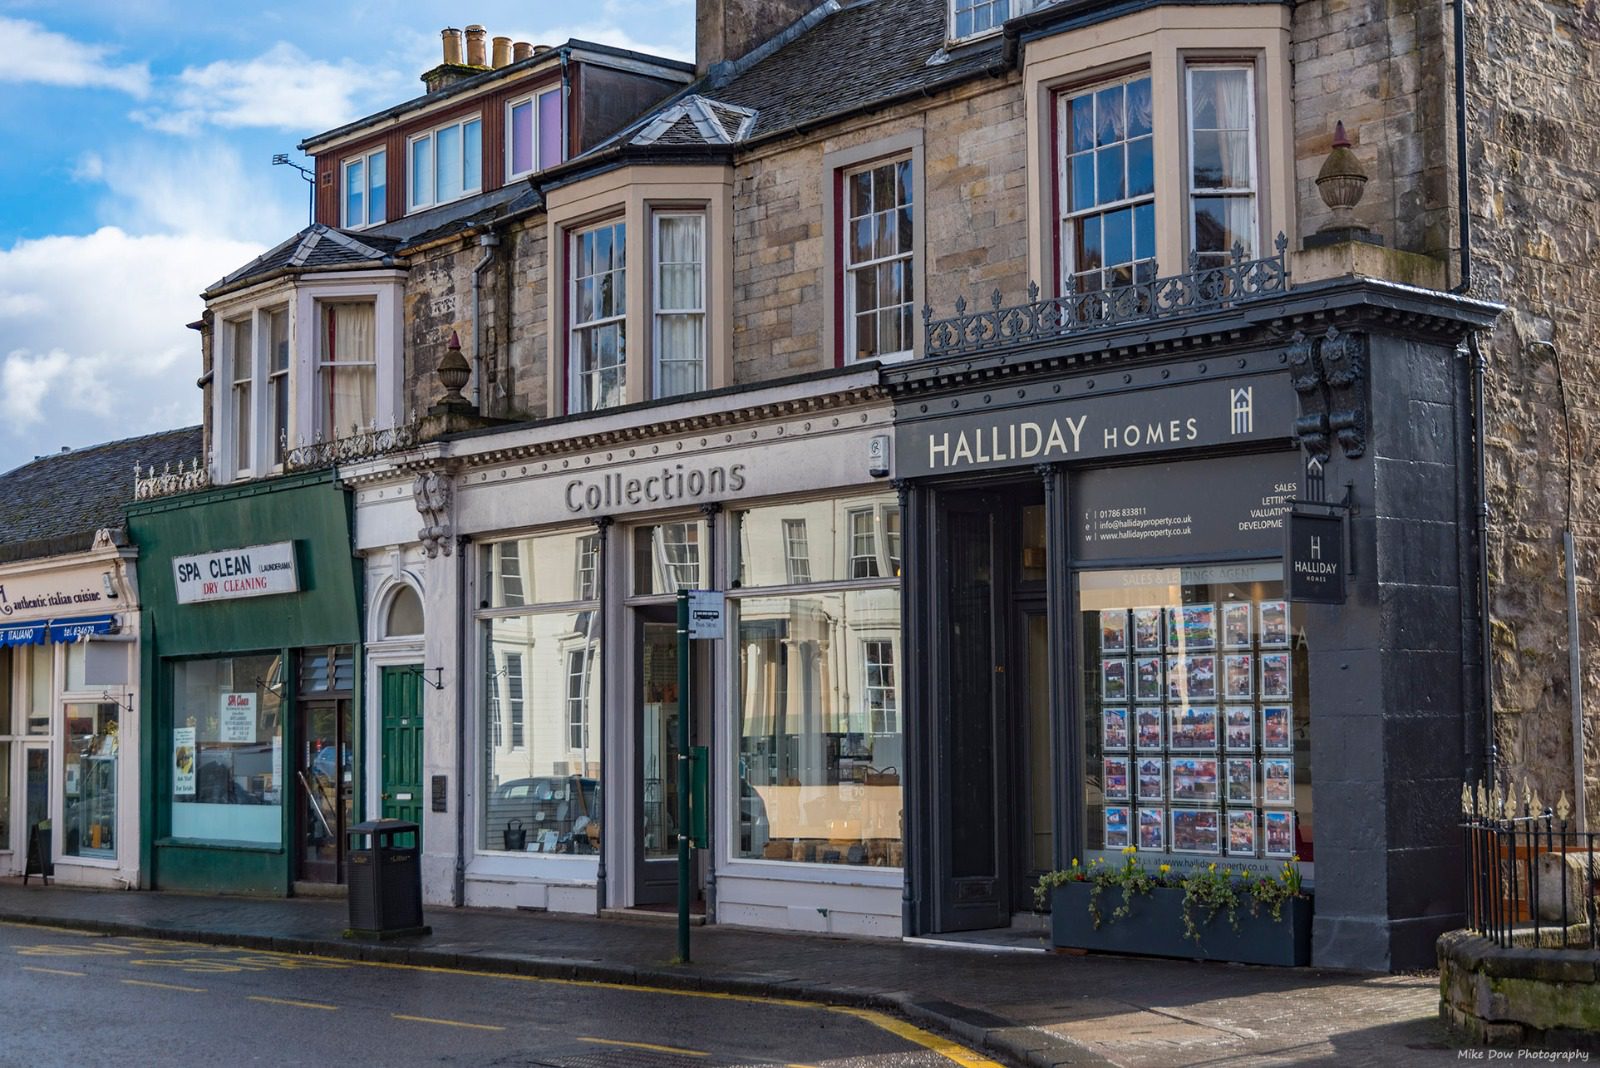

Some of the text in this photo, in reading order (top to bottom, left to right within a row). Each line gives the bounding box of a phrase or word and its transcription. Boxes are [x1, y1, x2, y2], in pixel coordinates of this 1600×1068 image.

[929, 415, 1198, 468] HALLIDAY HOMES
[564, 463, 746, 512] Collections
[1274, 482, 1297, 493] SALES
[1099, 509, 1121, 519] 01786
[1121, 507, 1146, 517] 833811
[1099, 514, 1192, 530] info@hallidayproperty.co.uk
[1238, 519, 1283, 531] DEVELOPME
[1100, 526, 1192, 540] www.hallidayproperty.co.uk
[178, 562, 201, 583] SPA
[209, 555, 251, 579] CLEAN
[1294, 560, 1337, 574] HALLIDAY
[1122, 574, 1152, 586] SALES
[1155, 574, 1163, 585] &
[1167, 569, 1214, 584] LETTINGS
[203, 576, 267, 595] DRY CLEANING
[13, 588, 101, 610] authentic italian cuisine
[8, 628, 34, 640] ITALIANO
[1163, 858, 1269, 873] www.halldaroperty.co.uk
